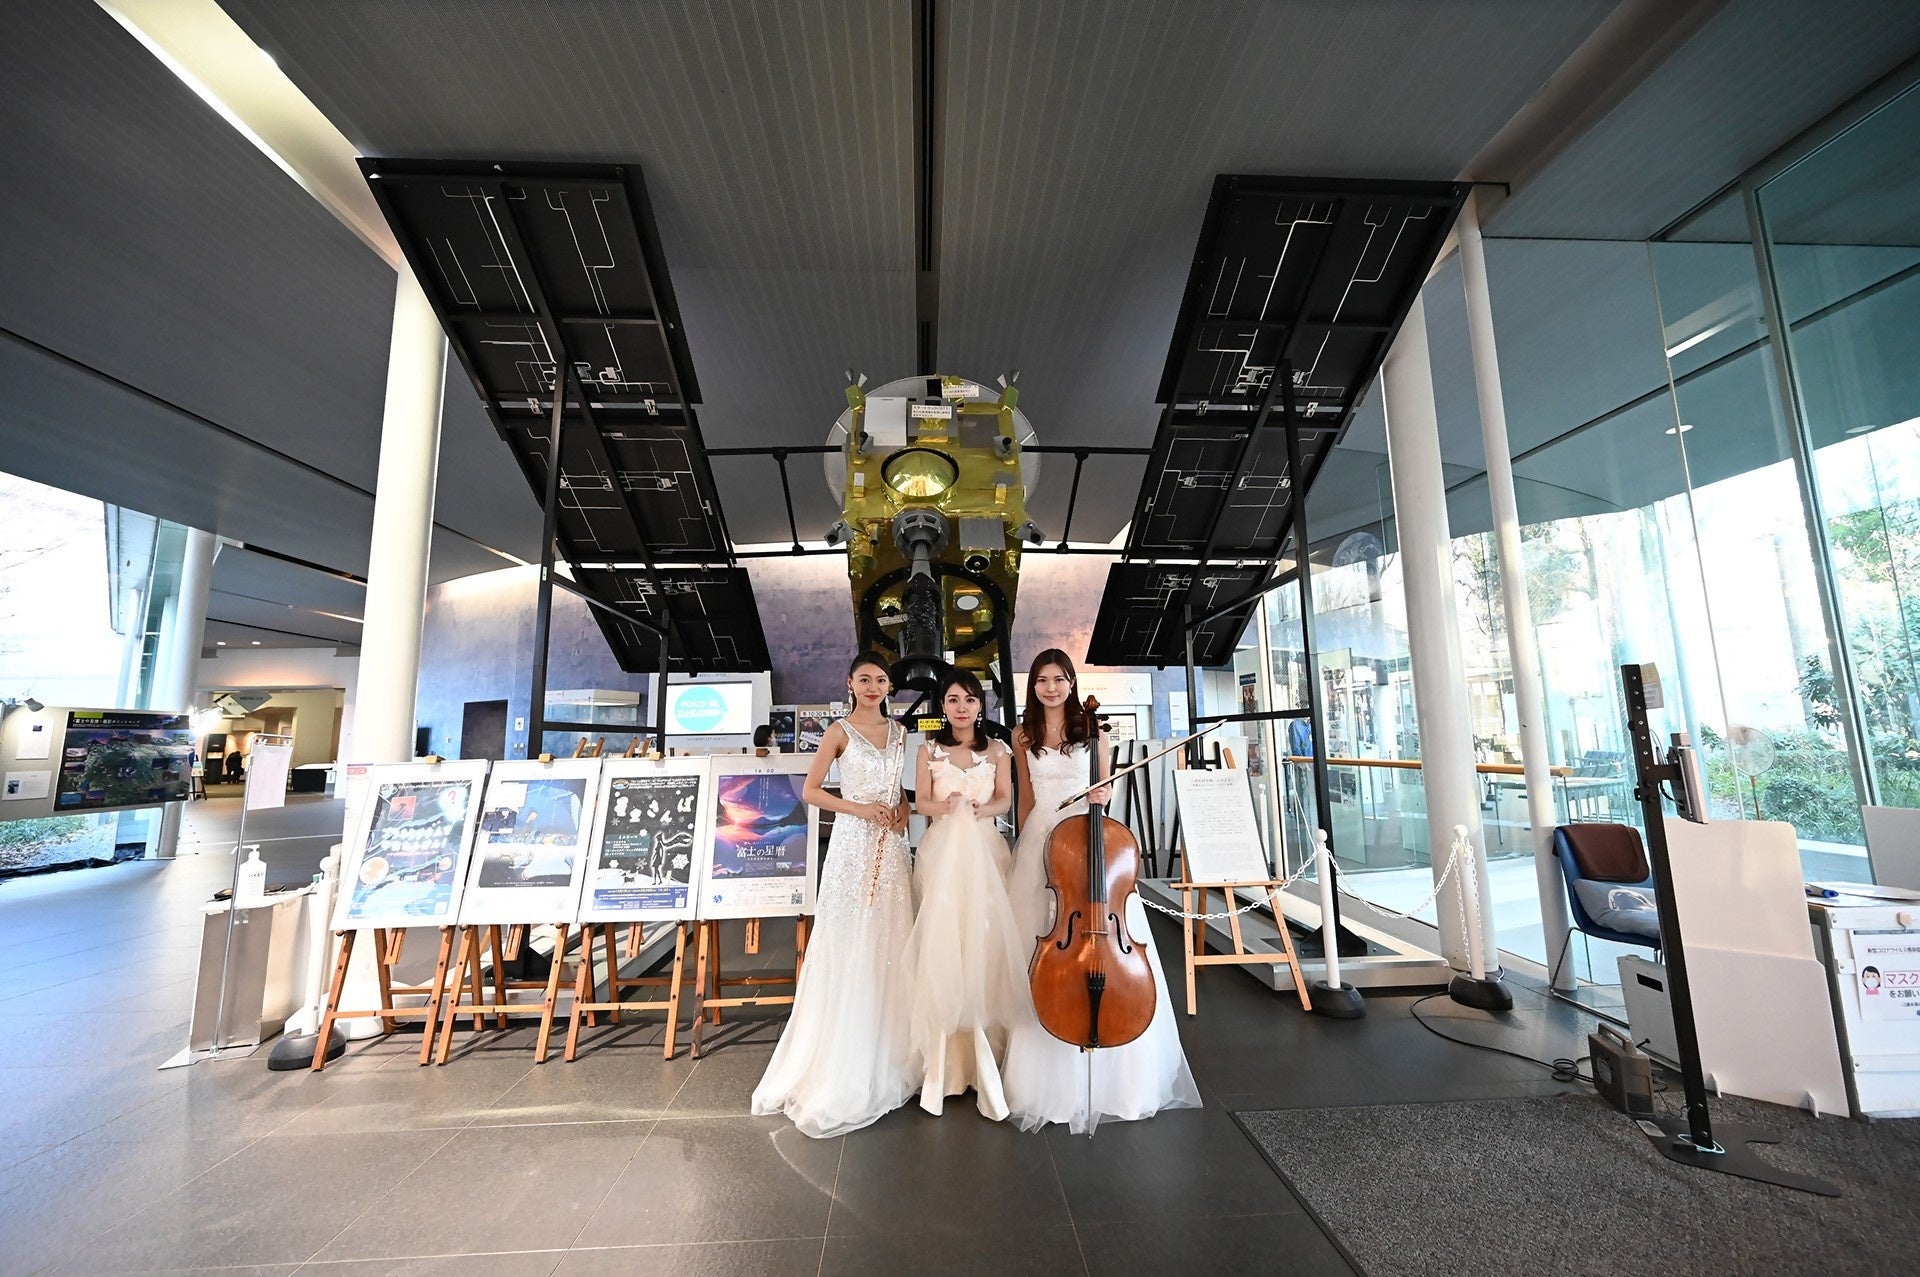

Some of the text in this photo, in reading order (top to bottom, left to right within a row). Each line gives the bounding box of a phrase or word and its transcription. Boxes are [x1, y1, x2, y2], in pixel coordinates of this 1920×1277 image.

[735, 844, 786, 858] 富士の星暦
[1886, 973, 1919, 985] マスク
